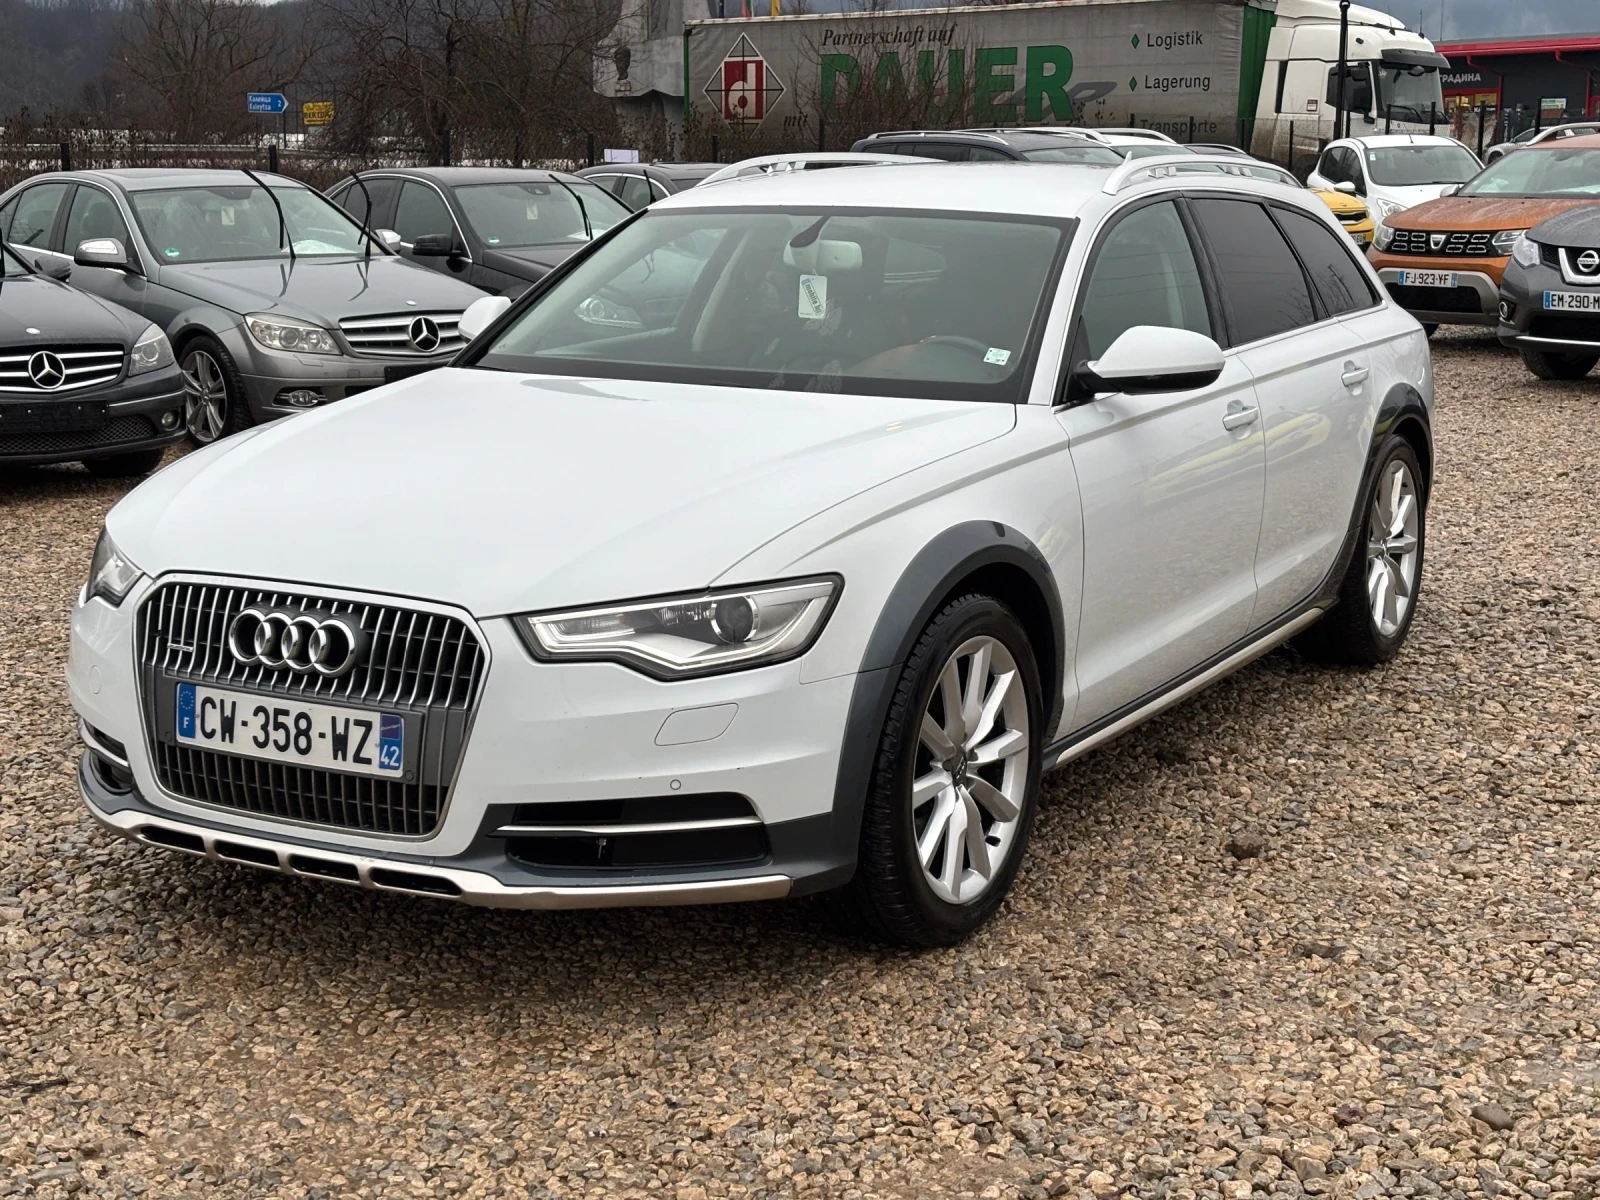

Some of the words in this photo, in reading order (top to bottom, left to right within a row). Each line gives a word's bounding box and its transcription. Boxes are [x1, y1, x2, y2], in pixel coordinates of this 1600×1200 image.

[822, 25, 925, 48] Partnerschaft
[928, 23, 958, 46] auf
[1147, 31, 1203, 50] Logistik
[821, 45, 1075, 123] DAUER
[1144, 75, 1211, 92] Lagerung
[277, 99, 282, 108] 2
[783, 115, 808, 128] mit
[1405, 272, 1449, 285] FJ-923-YF
[183, 716, 190, 729] F
[200, 696, 373, 765] CW-358-WZ
[380, 744, 400, 767] 42
